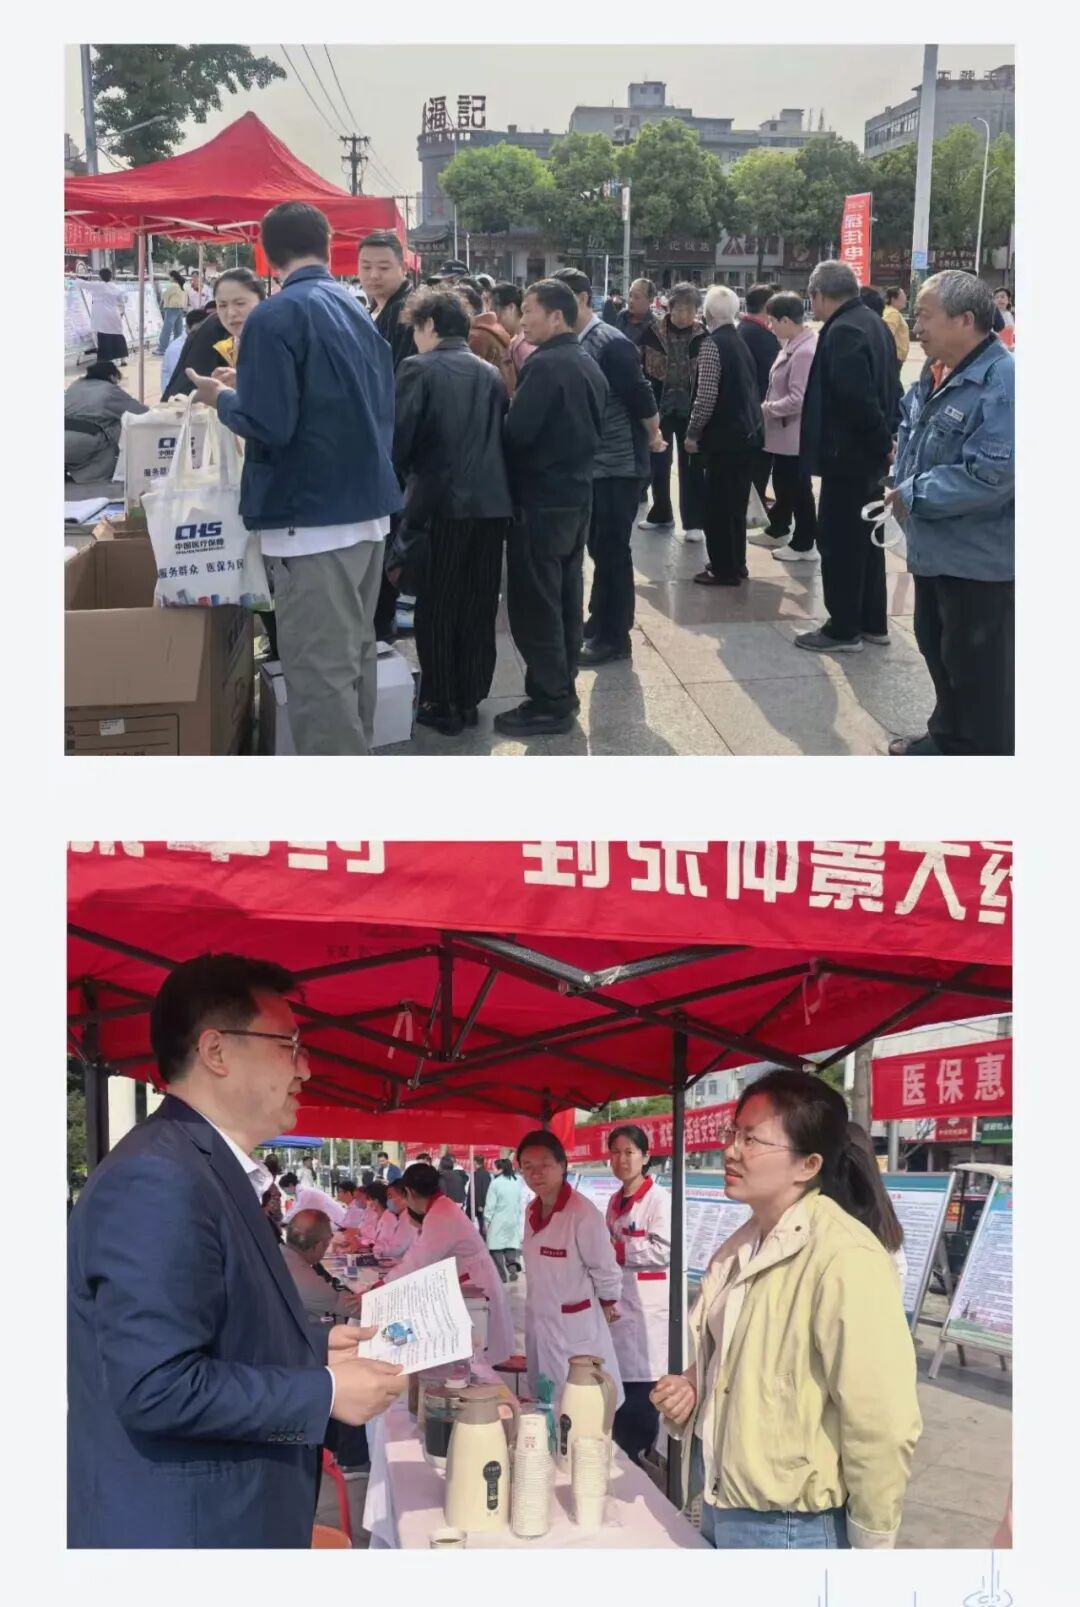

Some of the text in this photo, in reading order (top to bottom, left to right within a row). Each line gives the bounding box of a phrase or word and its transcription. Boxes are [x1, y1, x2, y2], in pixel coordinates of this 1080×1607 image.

[175, 521, 222, 540] CHS
[903, 1053, 1005, 1106] 医保惠
